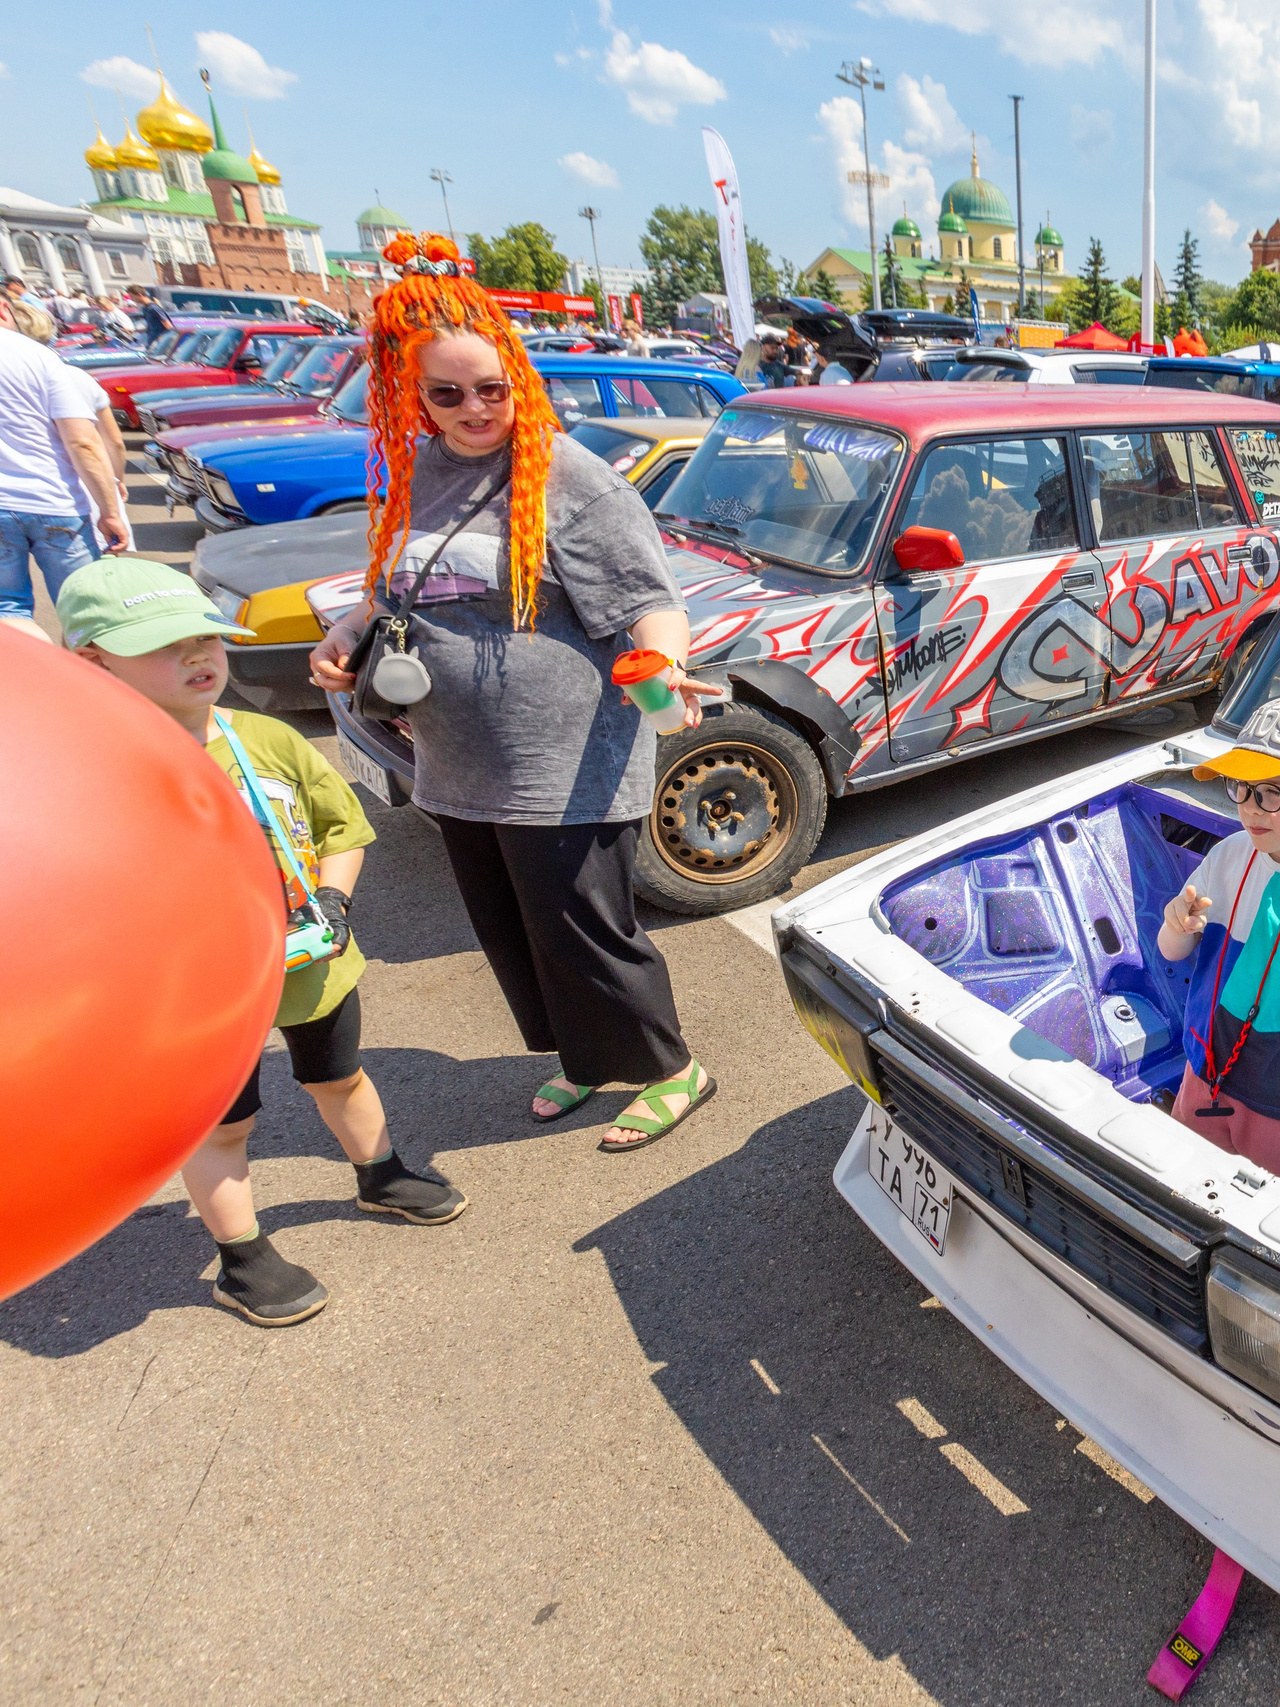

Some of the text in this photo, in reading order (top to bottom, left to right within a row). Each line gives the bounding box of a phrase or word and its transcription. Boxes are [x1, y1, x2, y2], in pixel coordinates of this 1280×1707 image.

[123, 592, 156, 608] born
[155, 590, 169, 598] to
[878, 1146, 939, 1232] ТА 71
[917, 1220, 931, 1237] RUS
[1174, 1639, 1199, 1661] OMP
